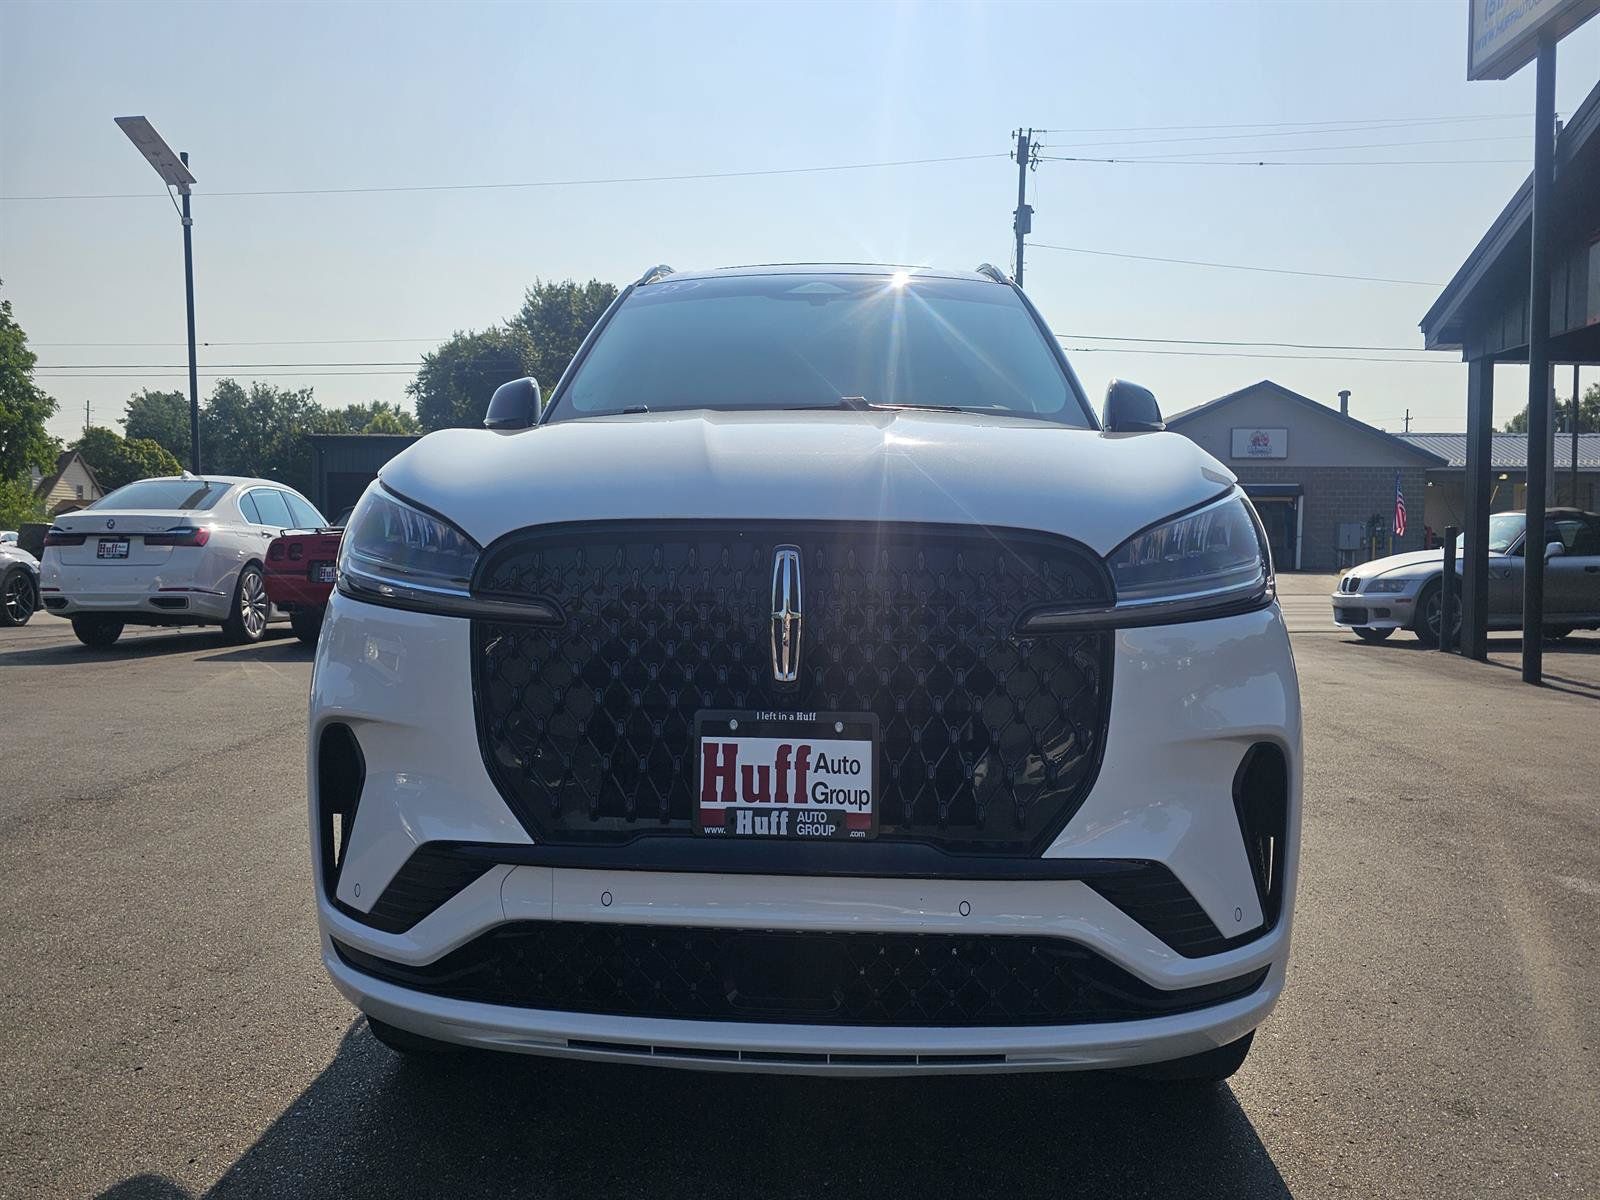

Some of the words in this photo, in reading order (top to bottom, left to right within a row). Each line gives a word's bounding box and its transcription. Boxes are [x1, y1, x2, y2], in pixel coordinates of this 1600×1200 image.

[98, 543, 118, 553] Huff
[761, 712, 777, 721] left
[778, 712, 787, 721] in
[796, 712, 817, 721] Huff
[813, 752, 861, 775] Auto
[701, 742, 812, 804] Huff
[811, 781, 871, 811] Group
[704, 826, 726, 835] www.
[736, 810, 789, 836] Huff
[796, 811, 827, 824] AUTO
[796, 824, 836, 836] GROUP
[849, 830, 866, 838] .com
